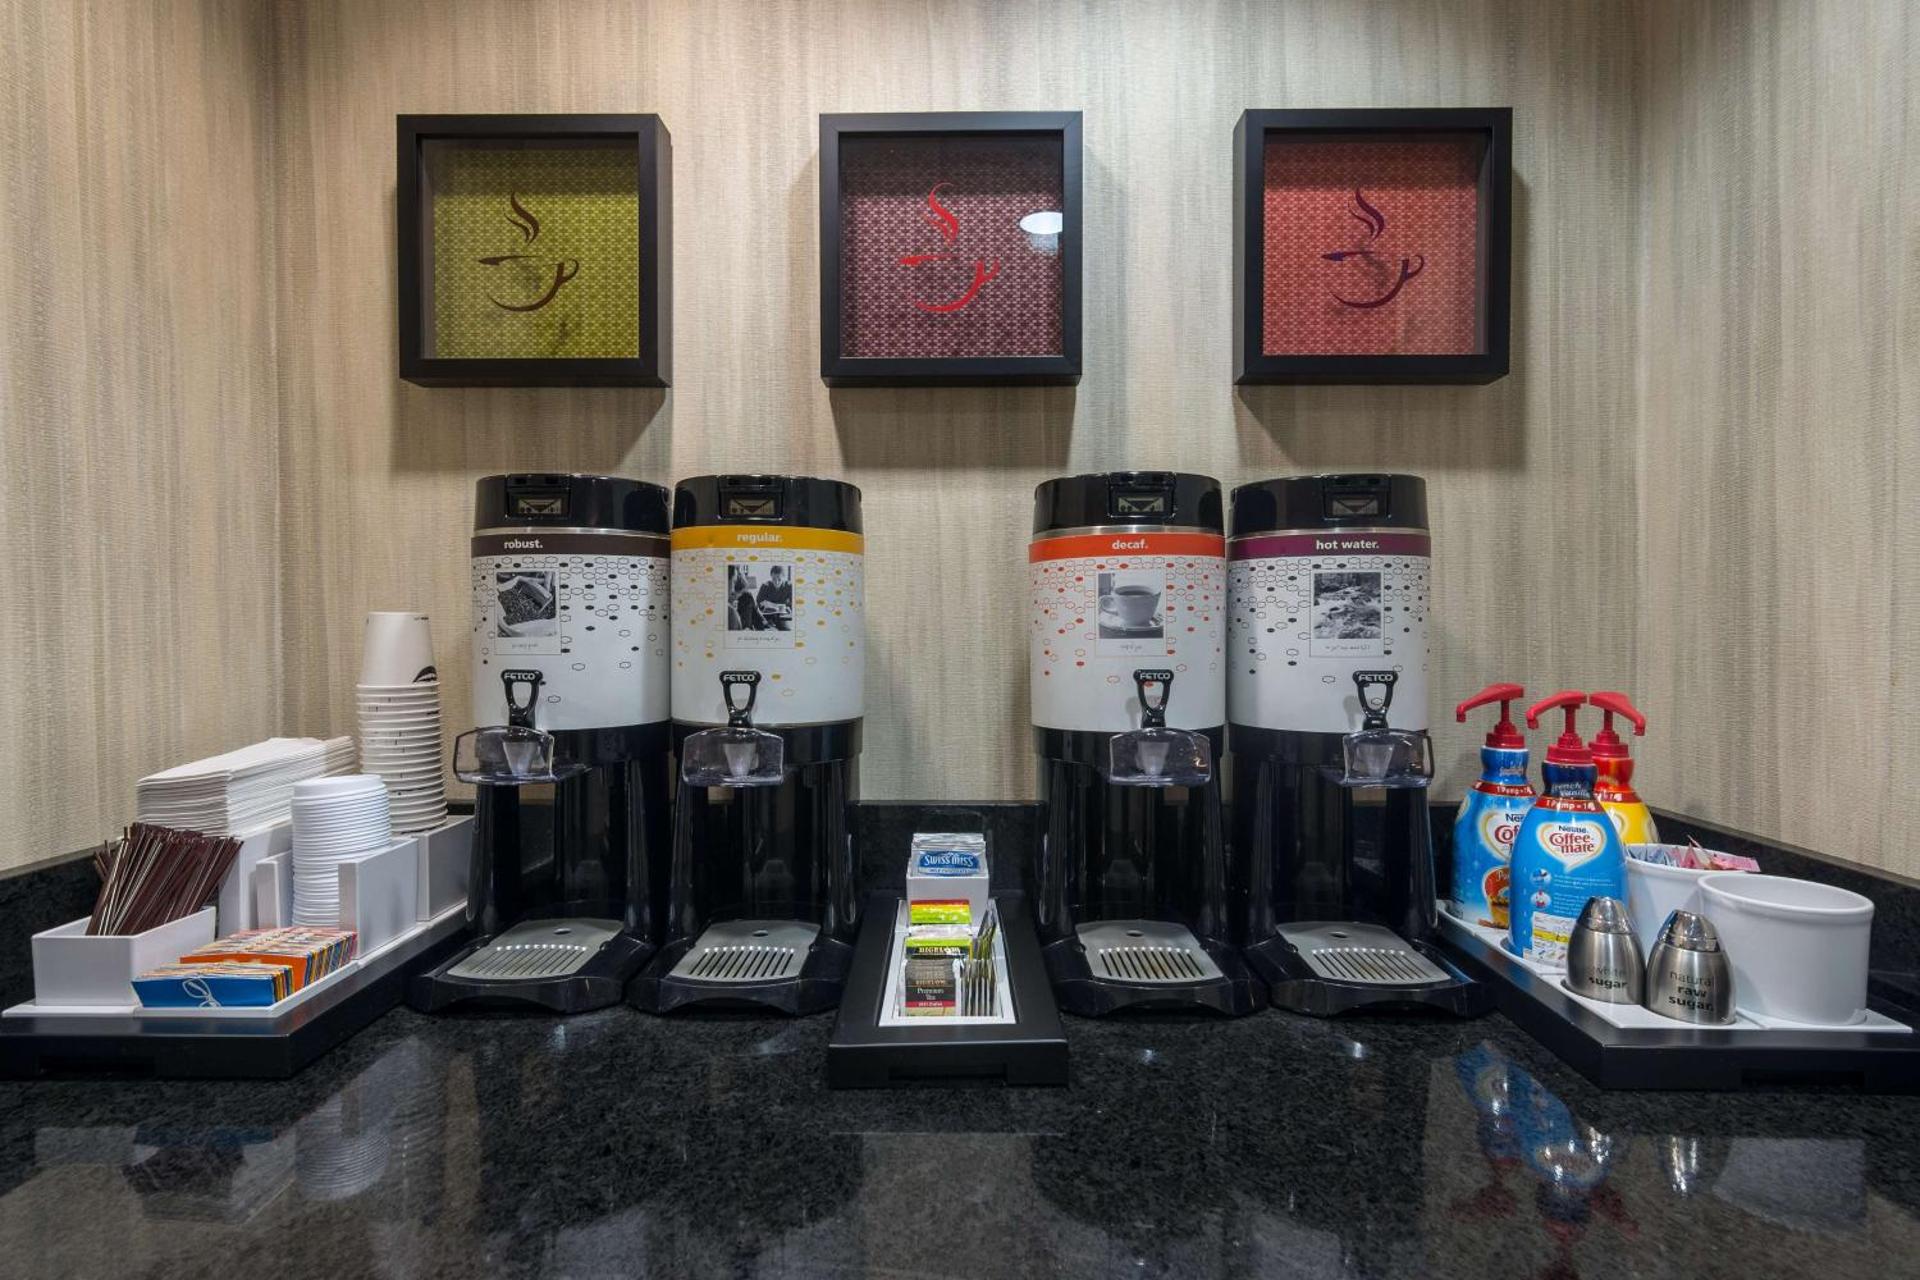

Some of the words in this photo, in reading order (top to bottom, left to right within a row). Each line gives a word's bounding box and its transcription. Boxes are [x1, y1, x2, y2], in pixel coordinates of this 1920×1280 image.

[503, 538, 544, 549] robust.
[736, 532, 783, 544] regular.
[1111, 538, 1149, 550] decaf.
[1316, 539, 1338, 550] hot
[1341, 539, 1380, 549] water.
[504, 672, 536, 681] FETCO
[723, 674, 755, 682] FETCO
[1140, 672, 1171, 680] FETCO
[1358, 674, 1393, 682] FETCO
[1561, 844, 1594, 854] mate
[1588, 976, 1628, 989] sugar
[1678, 986, 1707, 998] raw
[1669, 995, 1715, 1012] sugar
